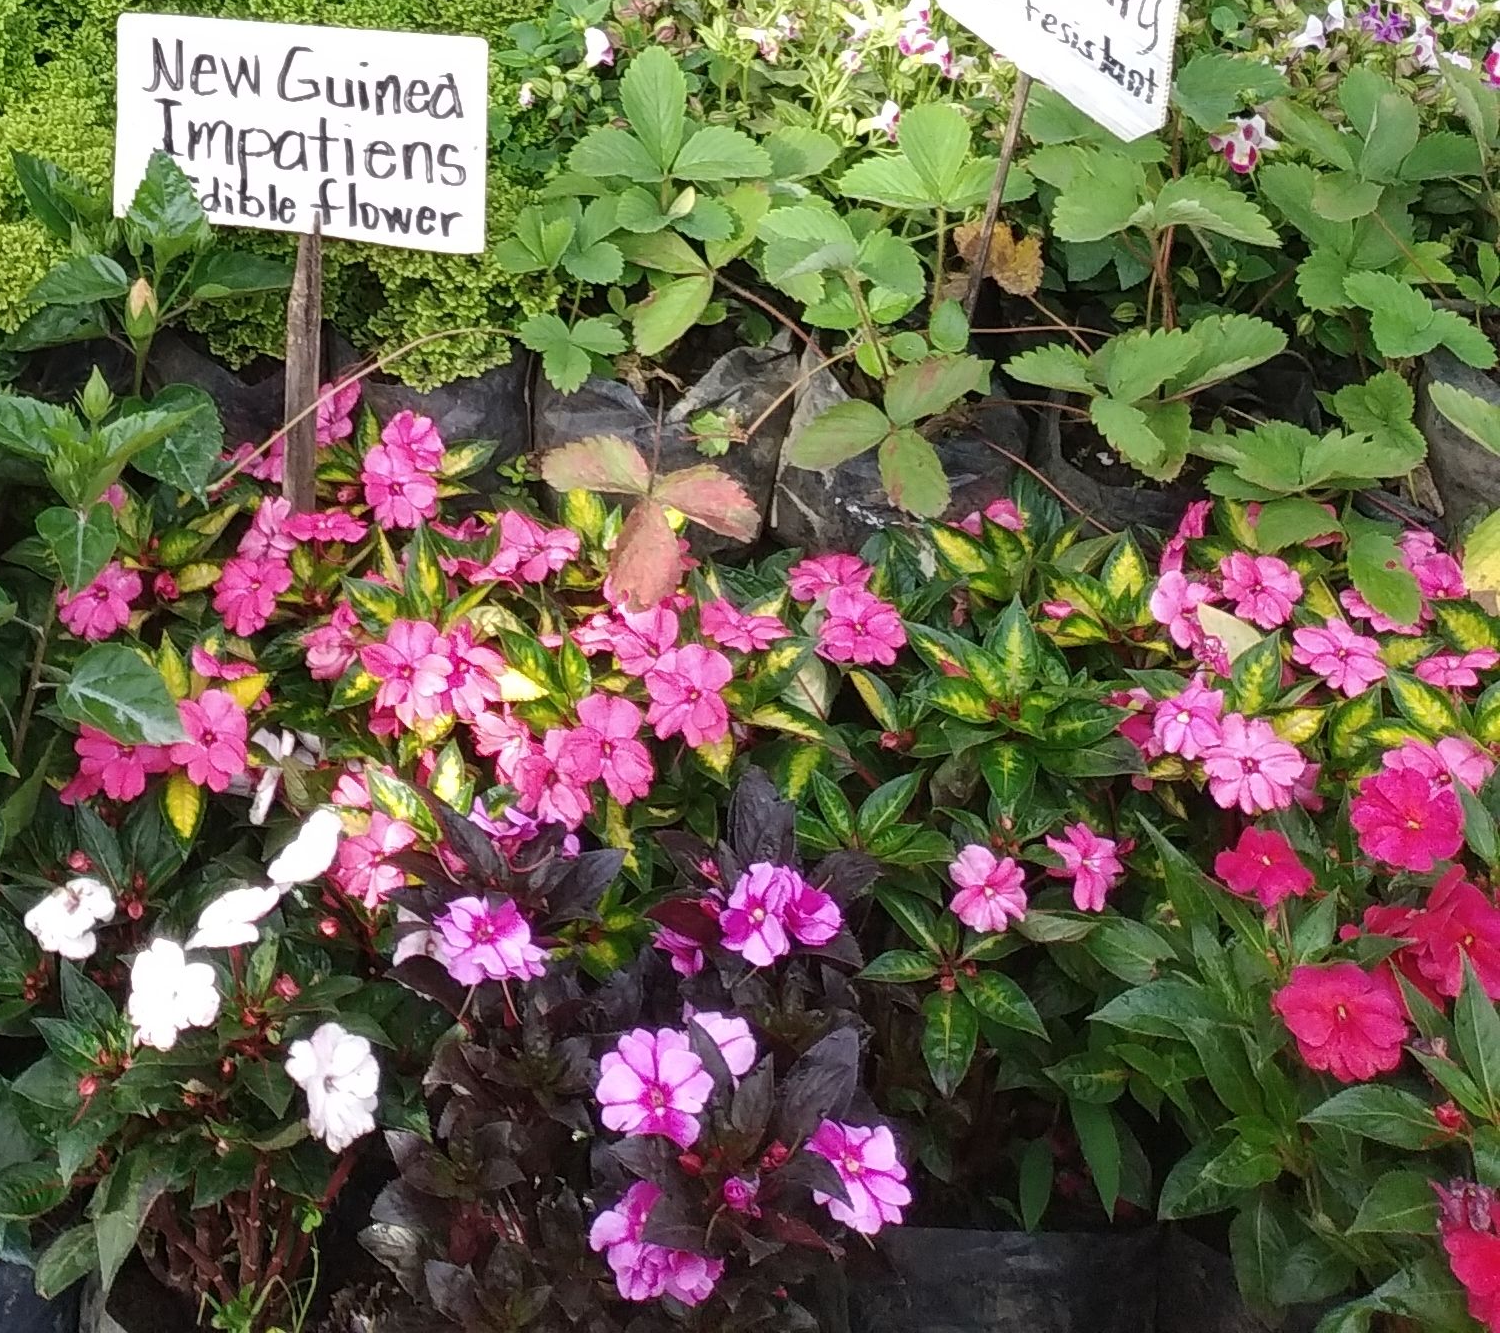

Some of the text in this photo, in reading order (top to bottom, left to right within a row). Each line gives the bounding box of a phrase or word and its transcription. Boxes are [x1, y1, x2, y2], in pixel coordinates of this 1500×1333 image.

[143, 37, 261, 97] New
[154, 98, 466, 186] Impatiens
[311, 178, 463, 237] flower
